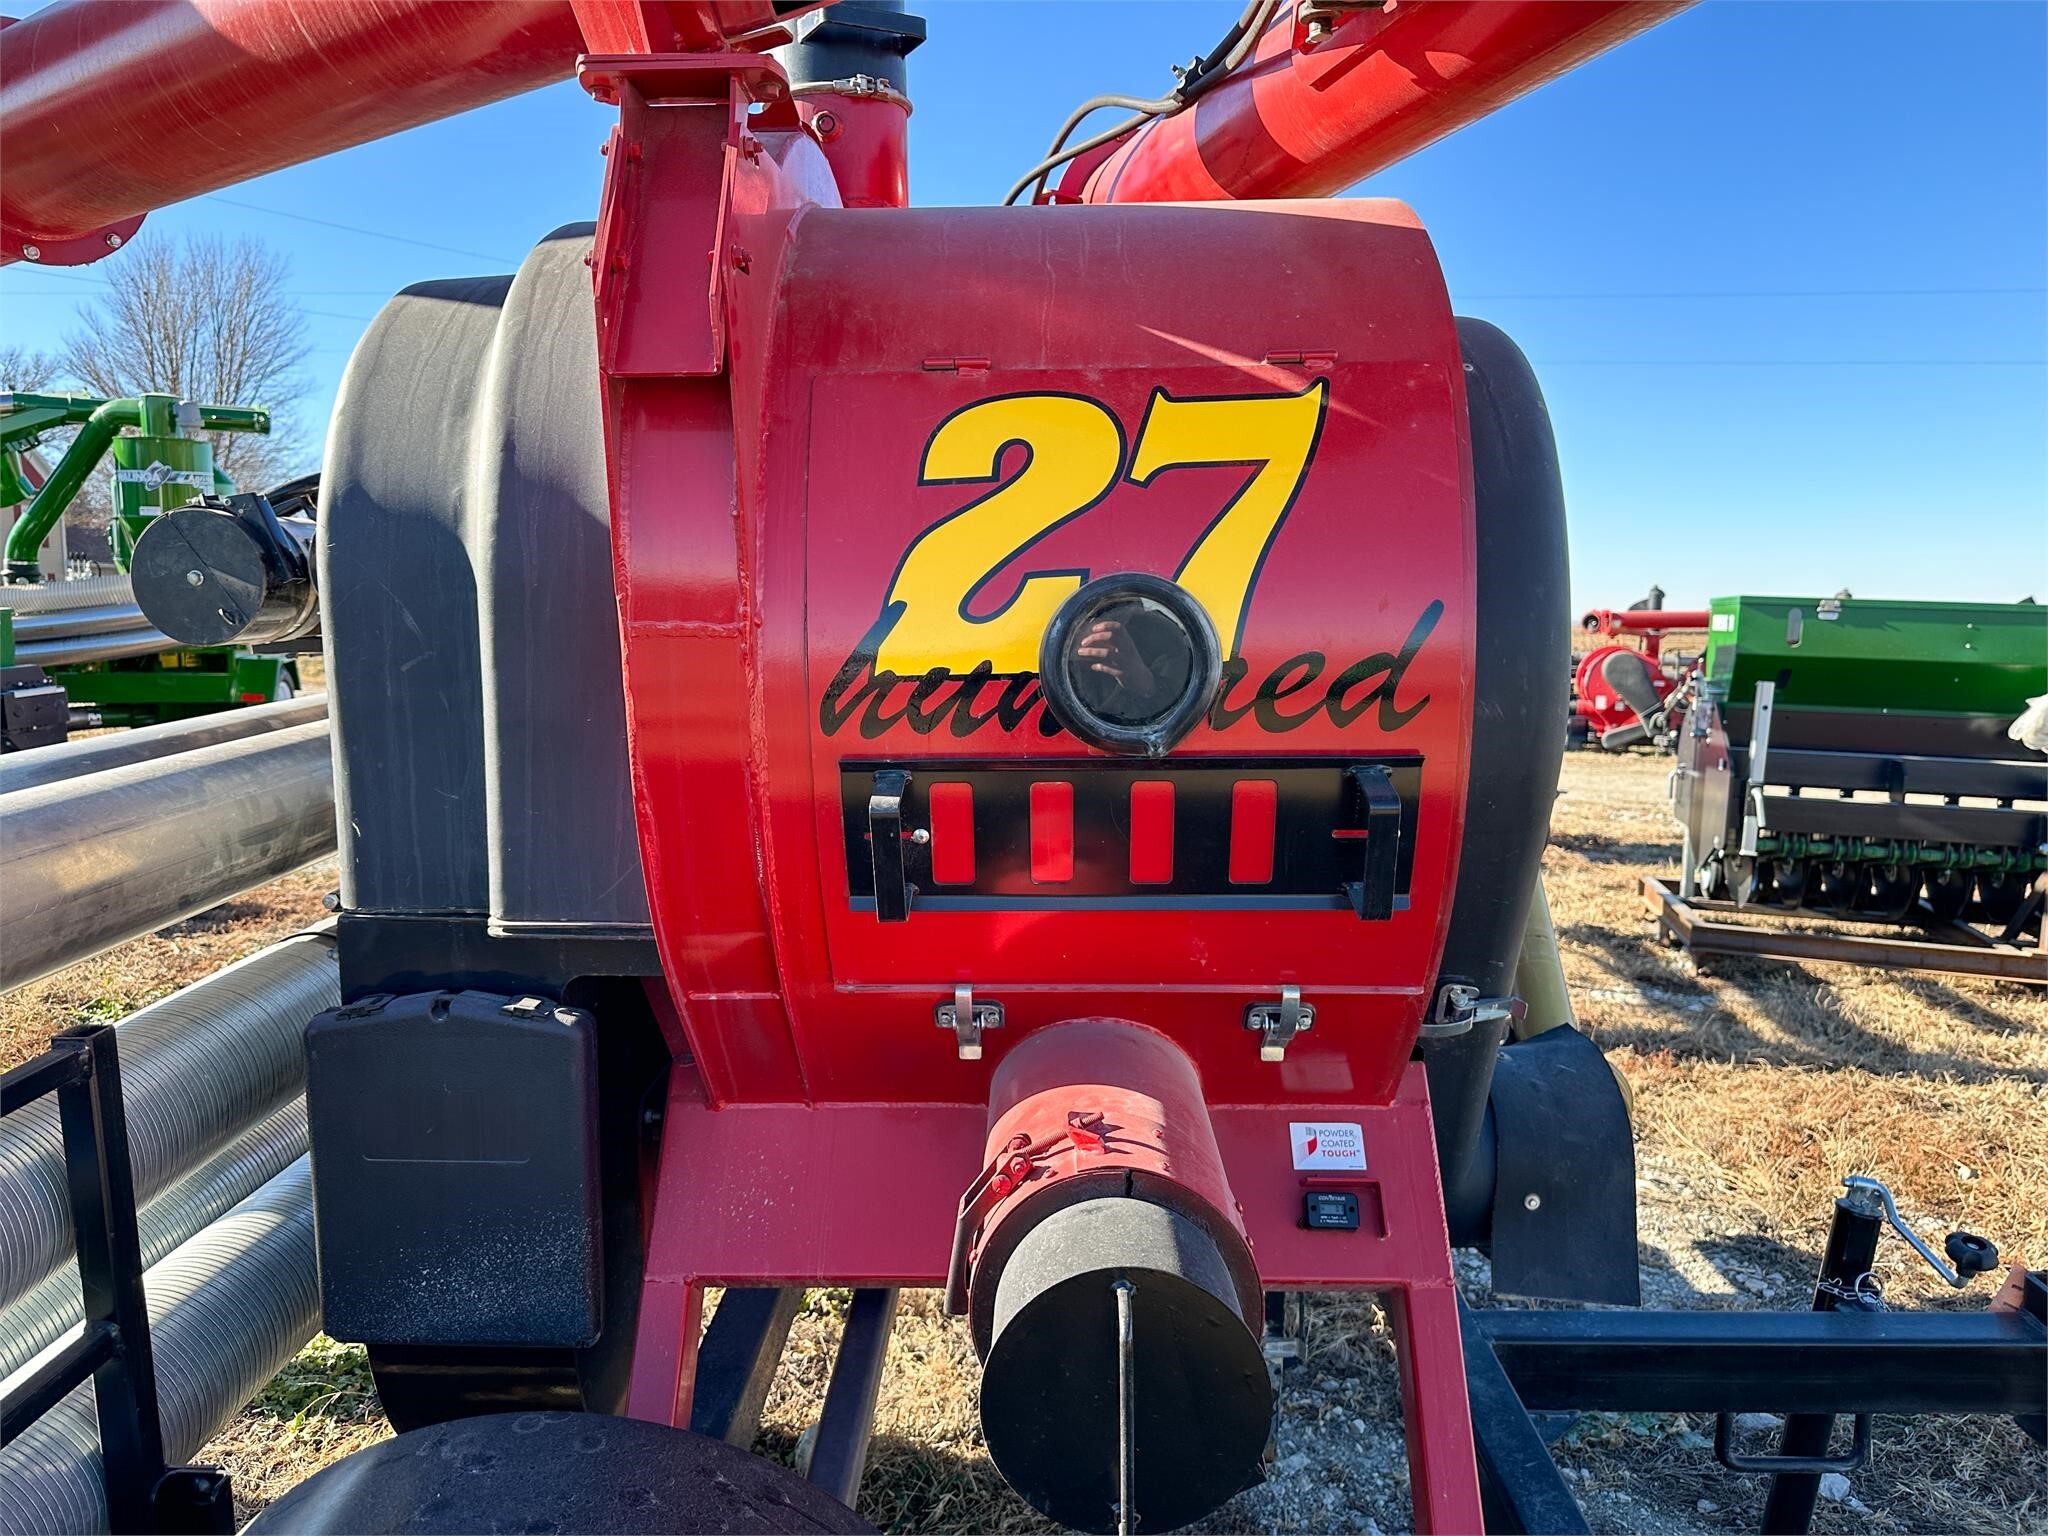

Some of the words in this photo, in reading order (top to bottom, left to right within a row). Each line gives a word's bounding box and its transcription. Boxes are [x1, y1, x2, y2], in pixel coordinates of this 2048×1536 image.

[874, 376, 1331, 678] 27
[819, 600, 1445, 740] hunred
[1318, 1129, 1355, 1138] POWDER
[1320, 1139, 1355, 1148] COATED
